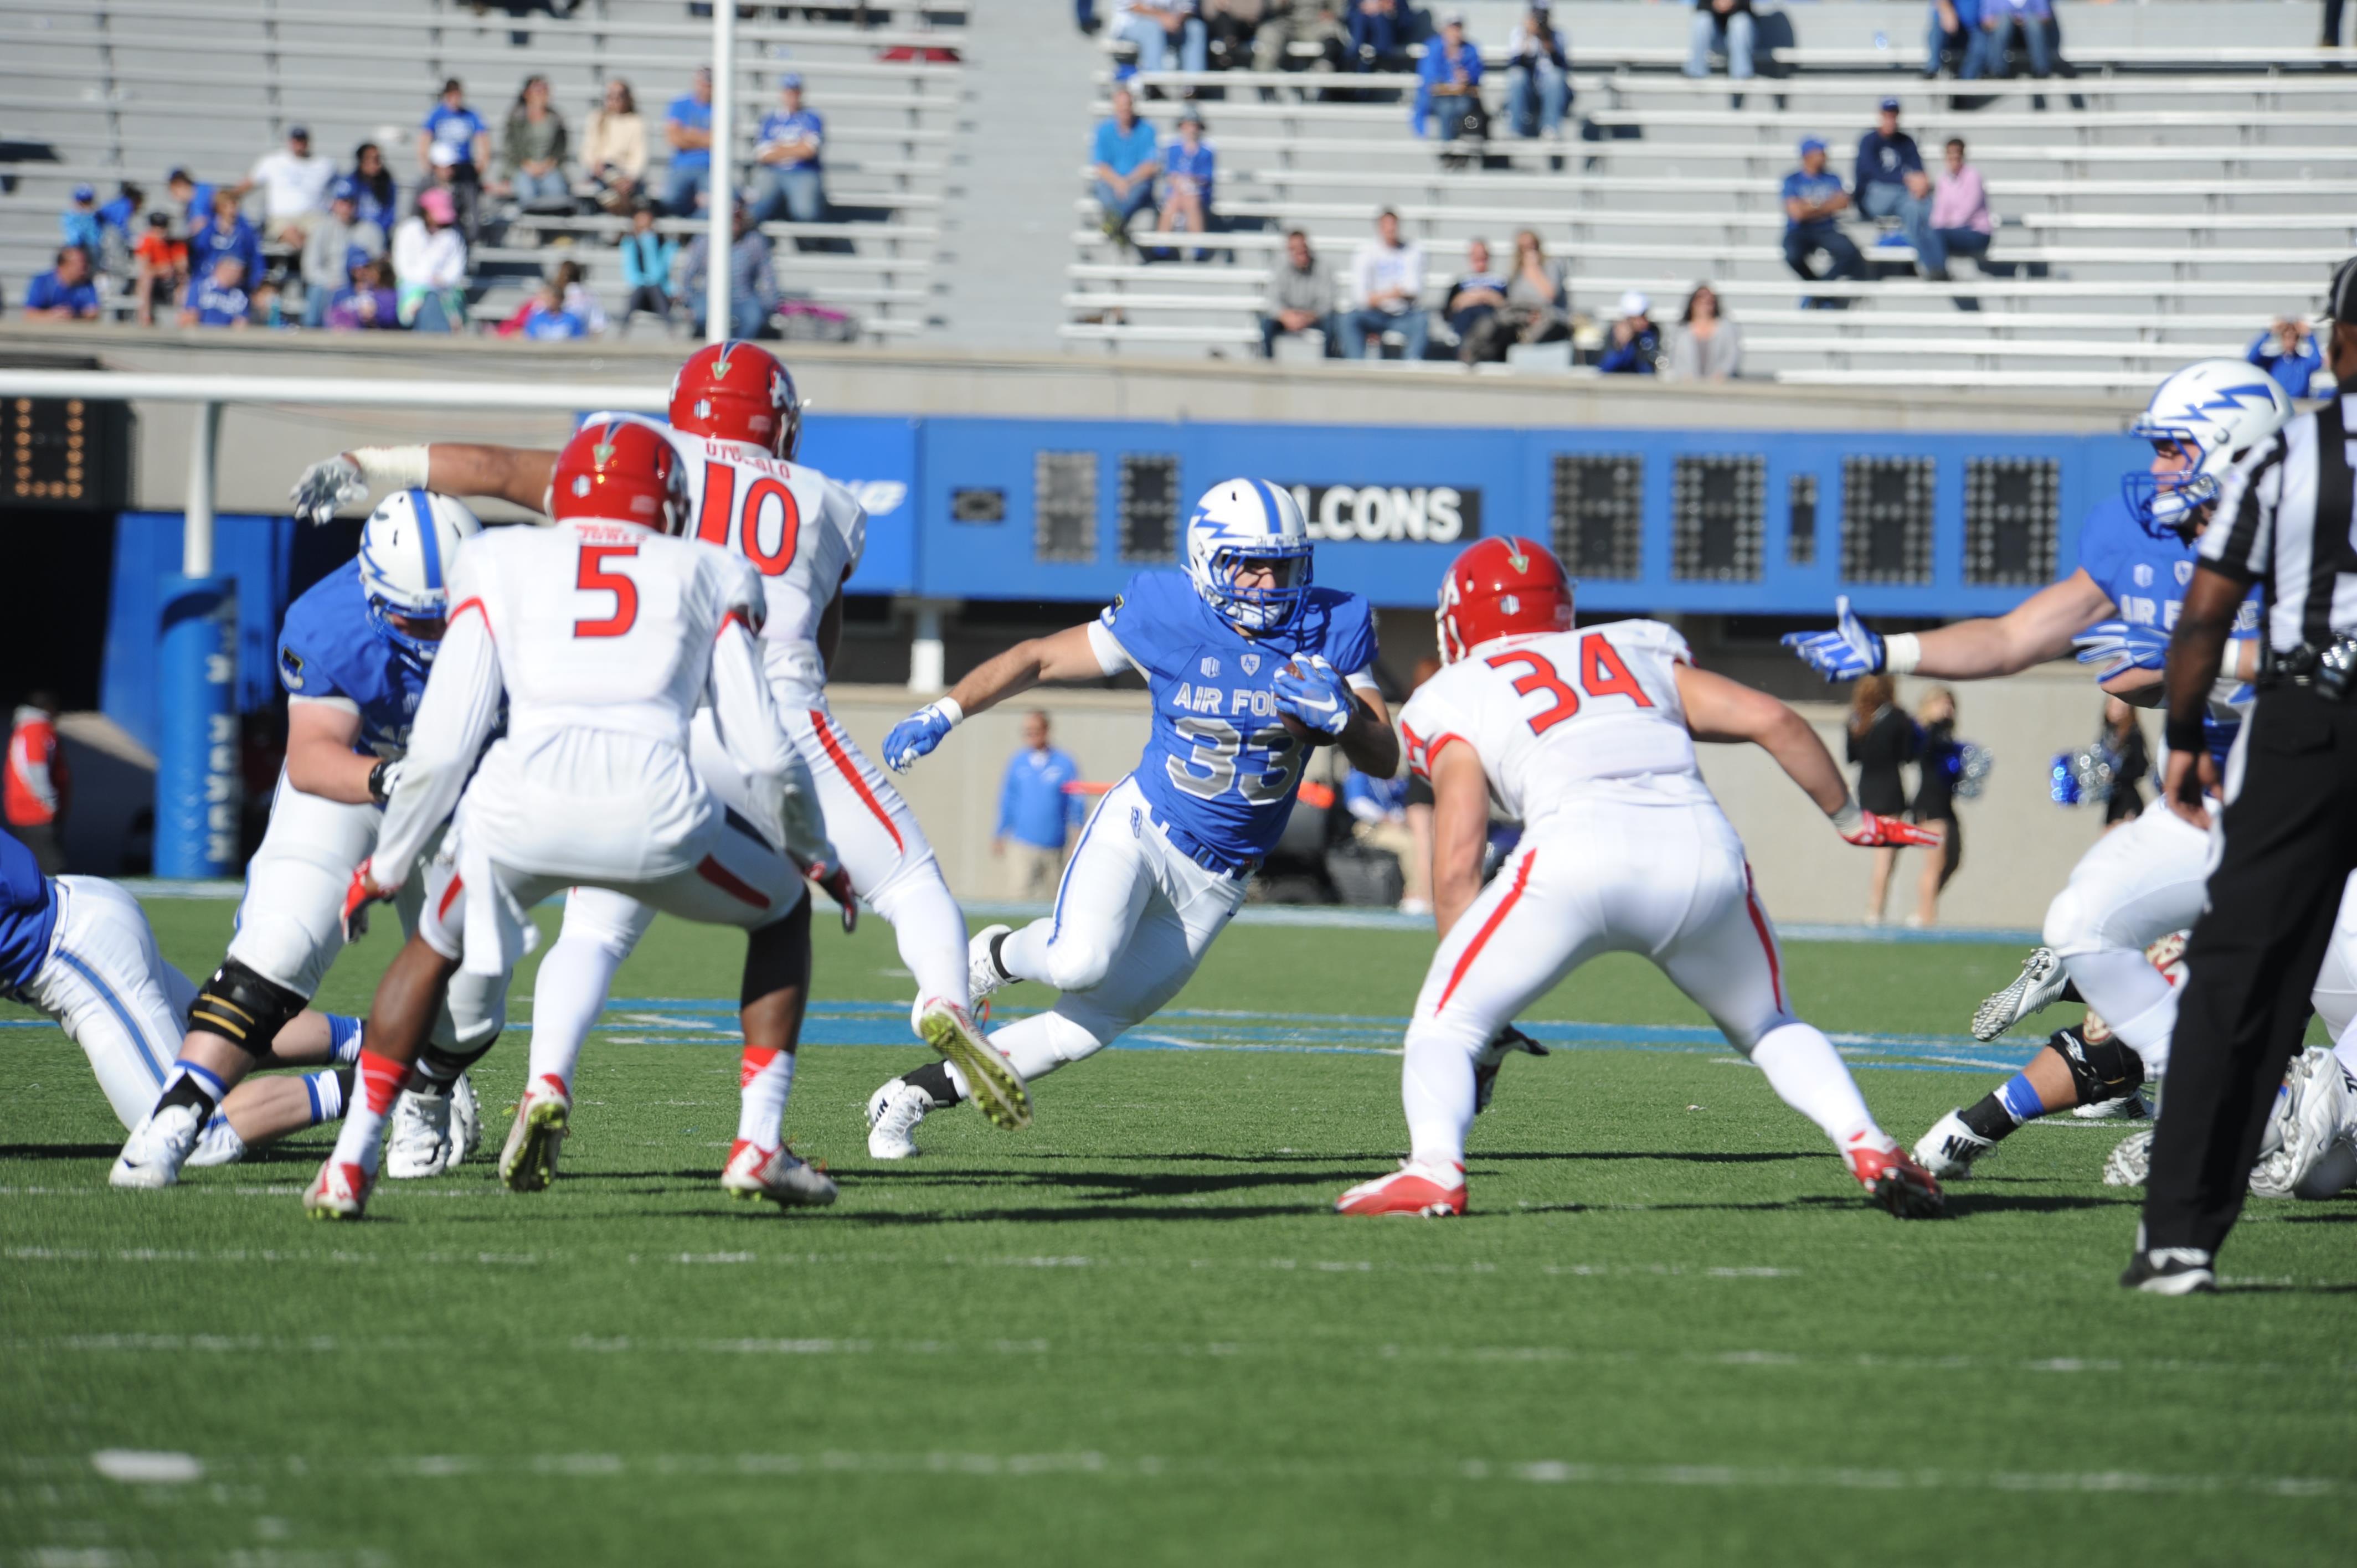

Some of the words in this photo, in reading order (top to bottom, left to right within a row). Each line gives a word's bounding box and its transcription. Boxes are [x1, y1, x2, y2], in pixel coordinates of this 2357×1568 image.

[696, 459, 800, 576] 10
[1291, 484, 1463, 543] LCONS
[574, 543, 639, 638] 5
[1173, 682, 1223, 714] AIR
[1484, 633, 1655, 737] 34
[1165, 716, 1305, 806] 33
